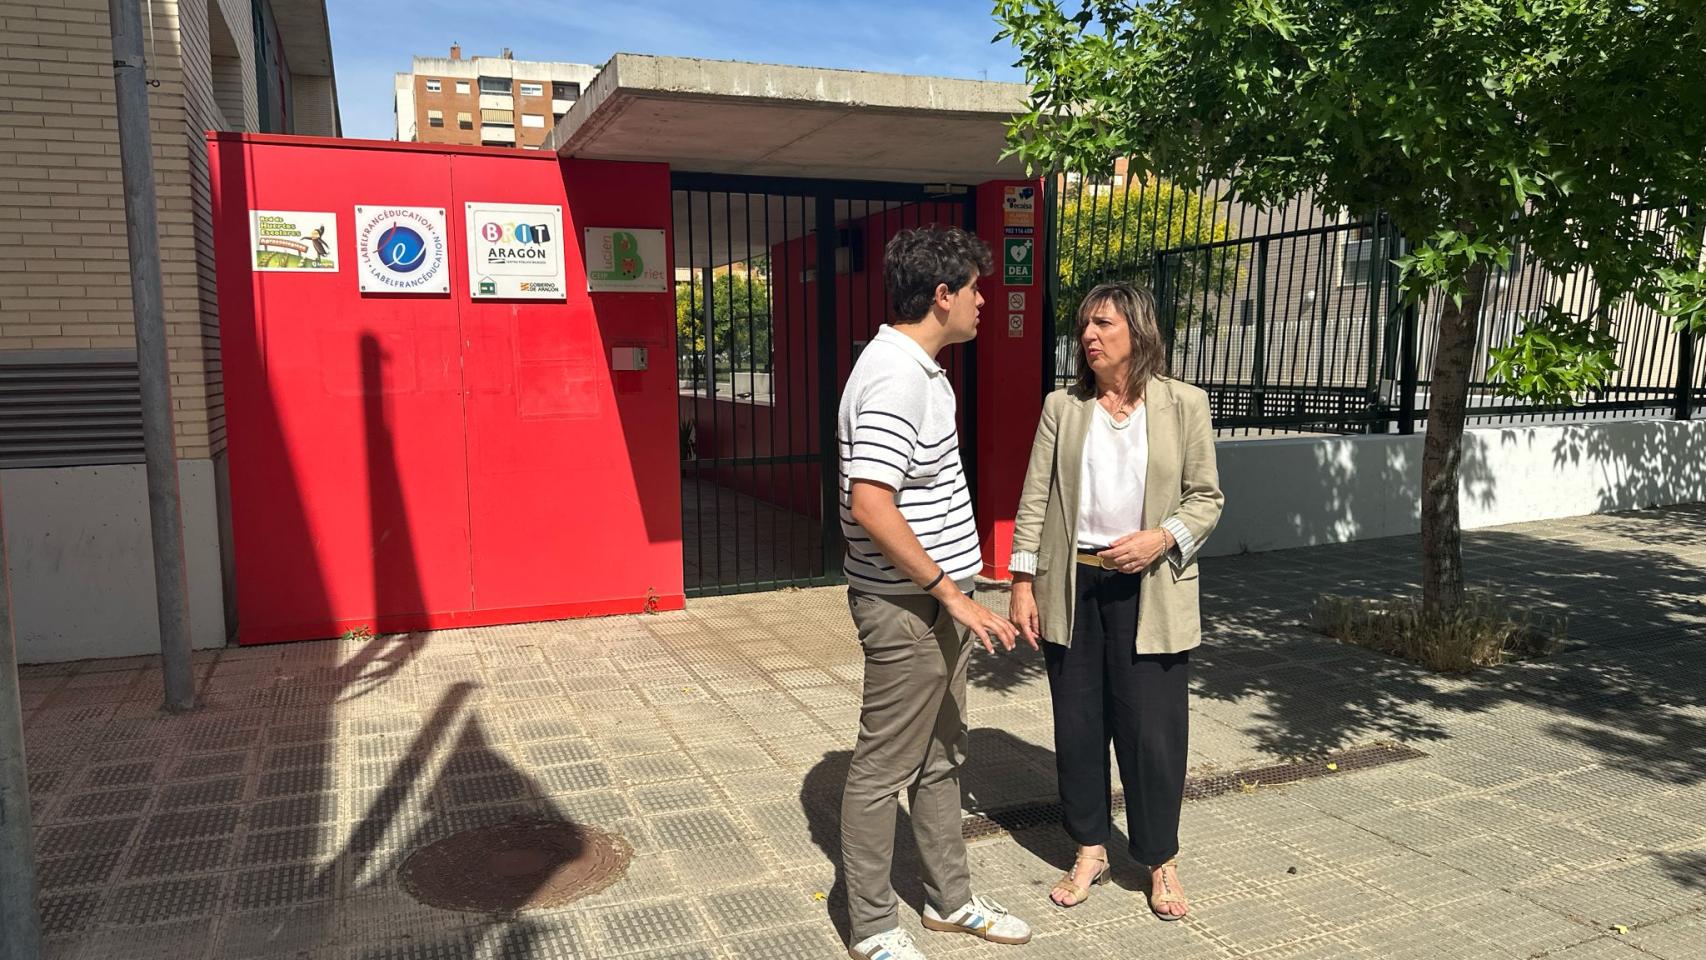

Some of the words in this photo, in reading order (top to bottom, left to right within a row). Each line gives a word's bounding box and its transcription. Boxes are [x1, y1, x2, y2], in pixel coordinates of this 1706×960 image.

[485, 222, 546, 244] BRIT
[488, 246, 546, 259] ARAGÓN
[1008, 266, 1028, 275] DEA
